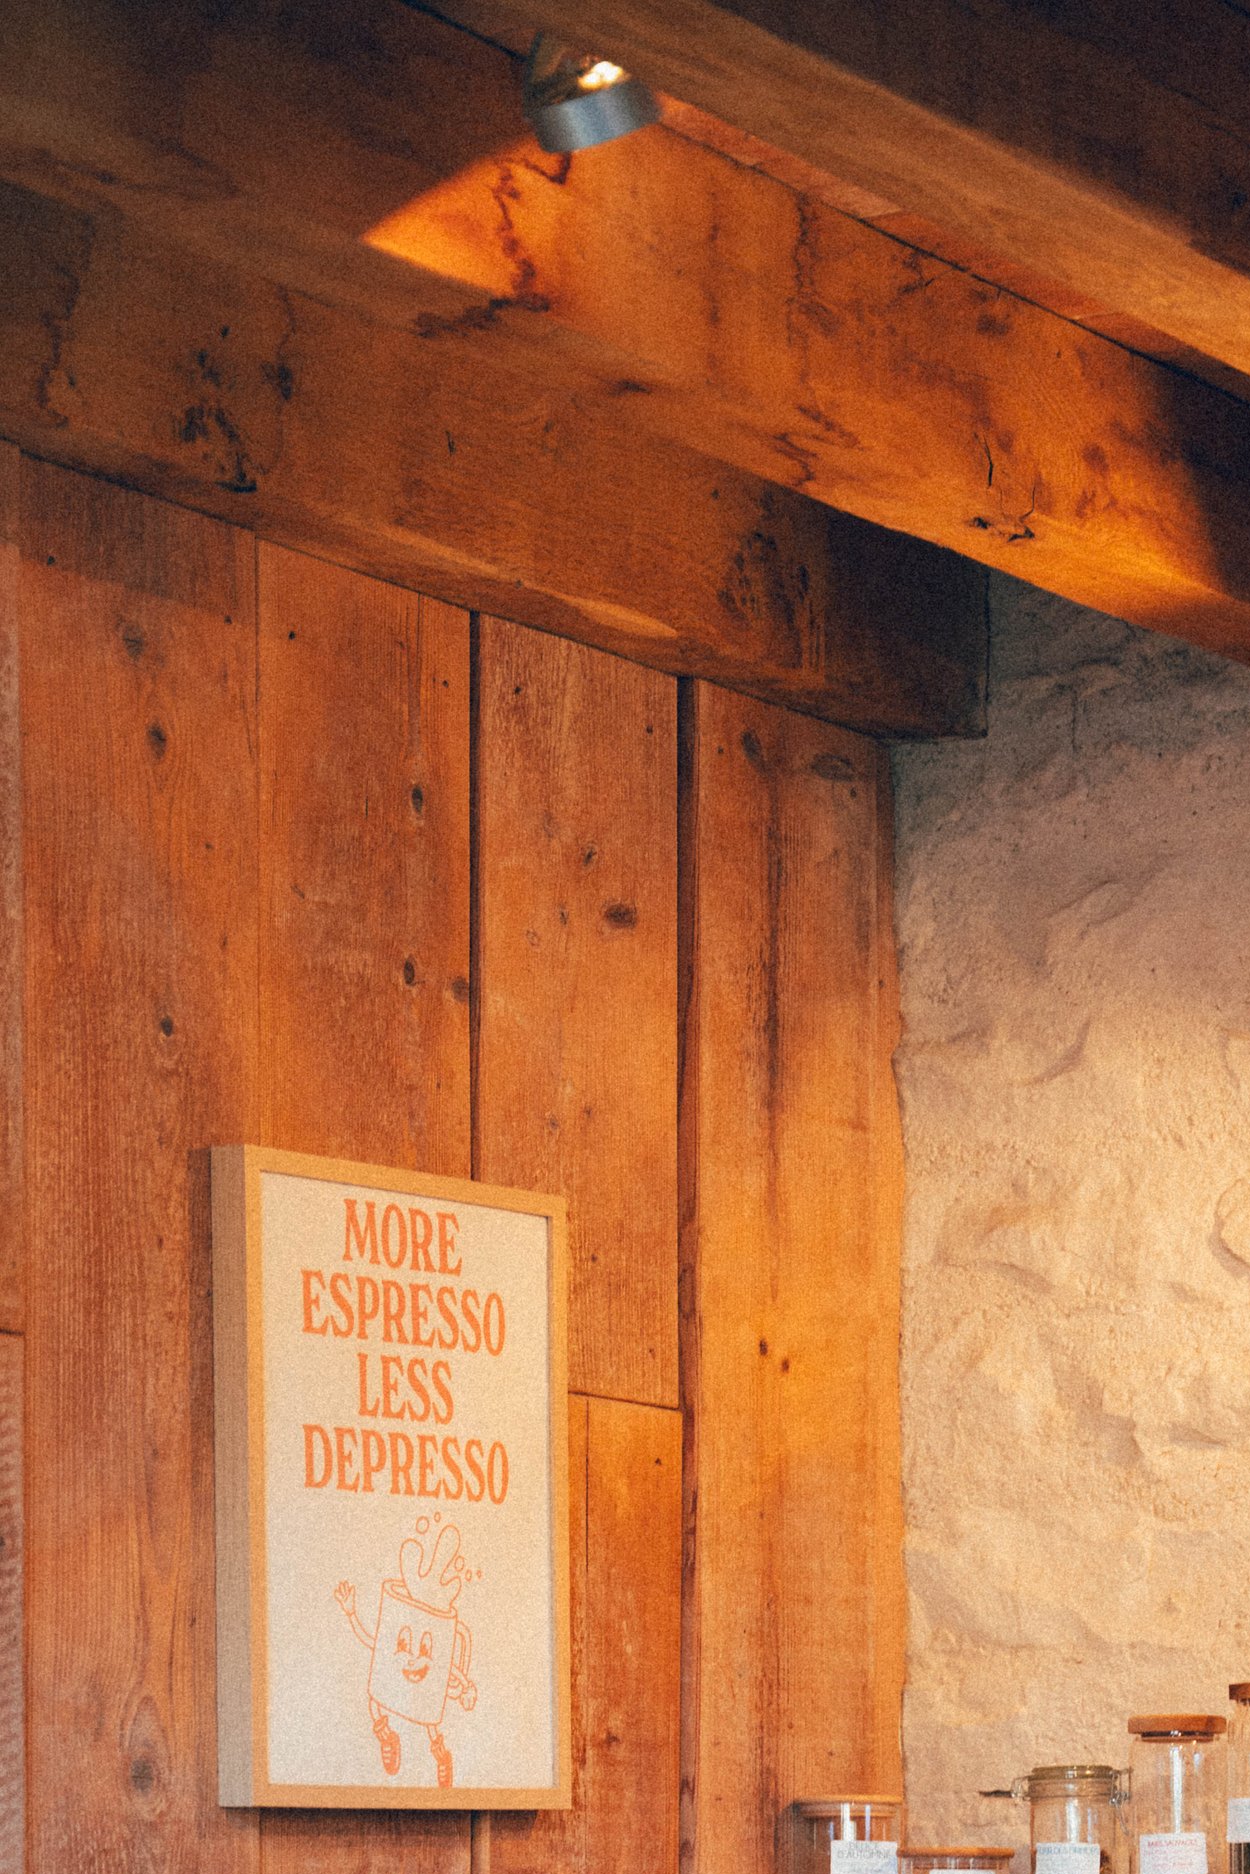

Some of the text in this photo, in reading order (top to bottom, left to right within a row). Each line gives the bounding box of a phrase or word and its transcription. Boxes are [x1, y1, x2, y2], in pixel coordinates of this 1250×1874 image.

[342, 1197, 463, 1278] MORE
[301, 1269, 506, 1357] ESPRESSO
[357, 1352, 455, 1427] LESS
[303, 1423, 510, 1507] DEPRESSO
